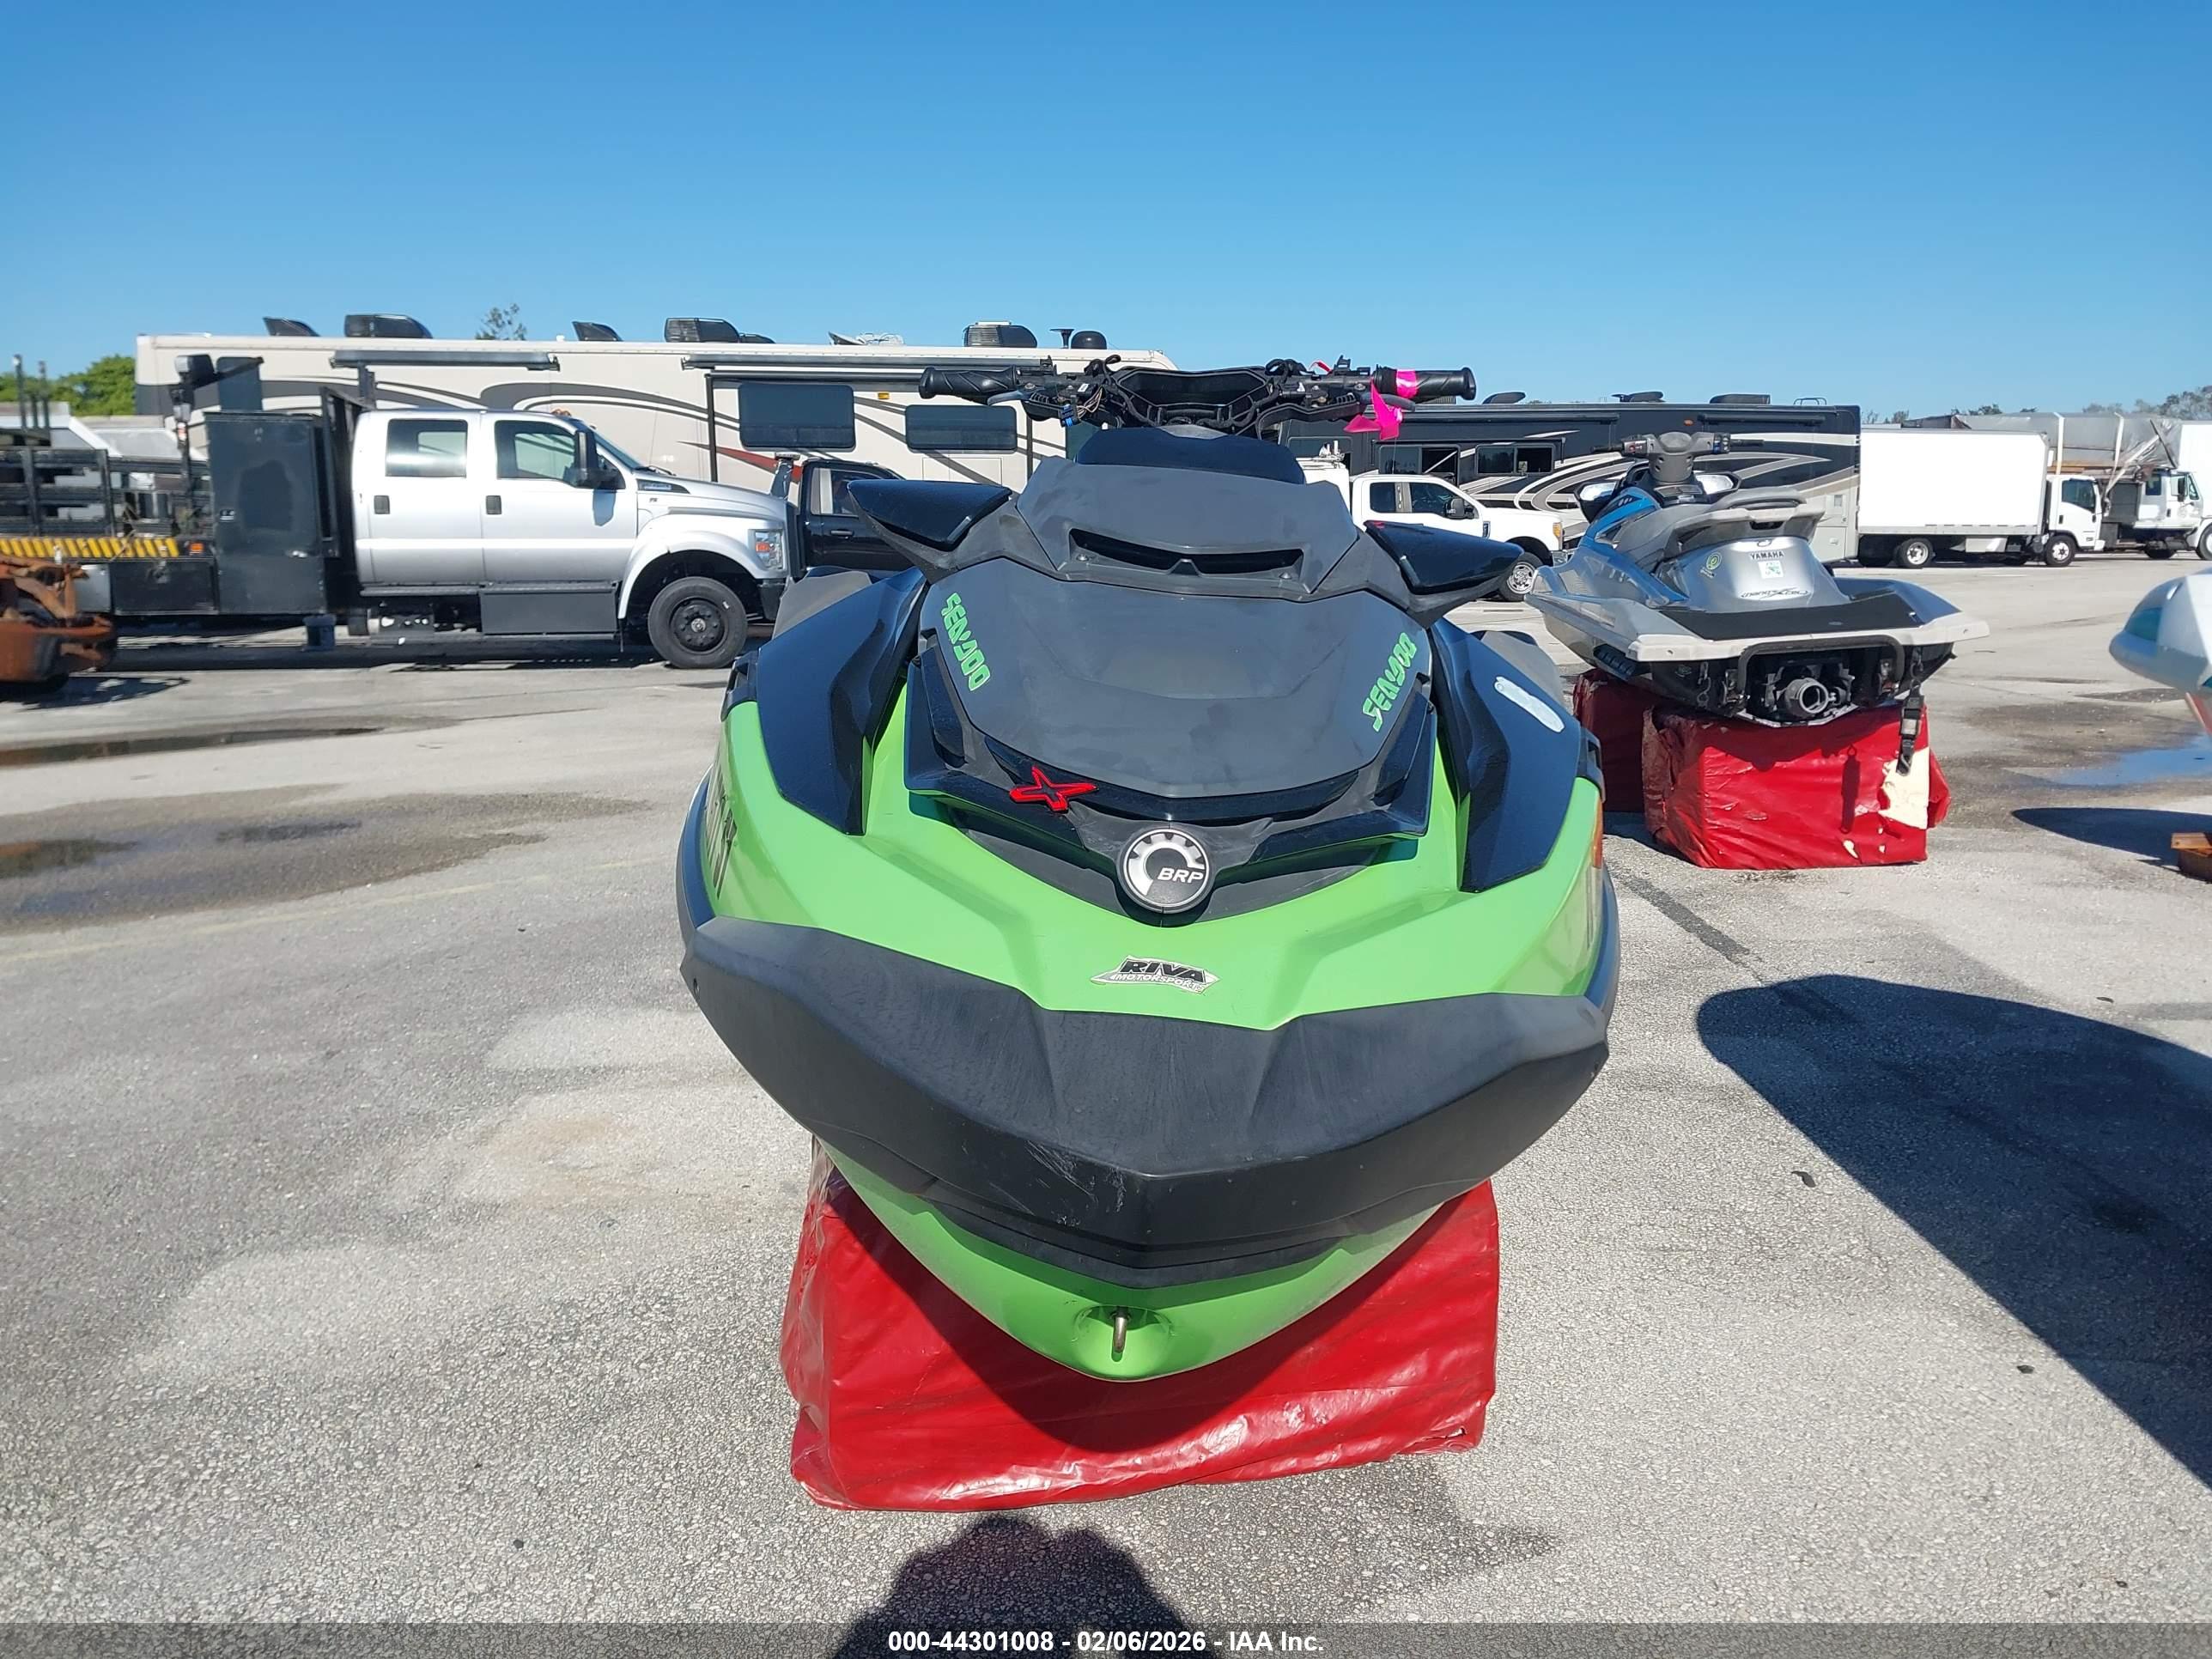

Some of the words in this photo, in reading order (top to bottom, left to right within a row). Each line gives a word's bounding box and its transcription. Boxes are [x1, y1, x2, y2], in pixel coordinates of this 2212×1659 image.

[1750, 550, 1784, 560] YAMAHA
[1157, 866, 1204, 884] BRP
[1119, 958, 1206, 983] RIVA
[1110, 973, 1207, 993] MOTORSPORTS
